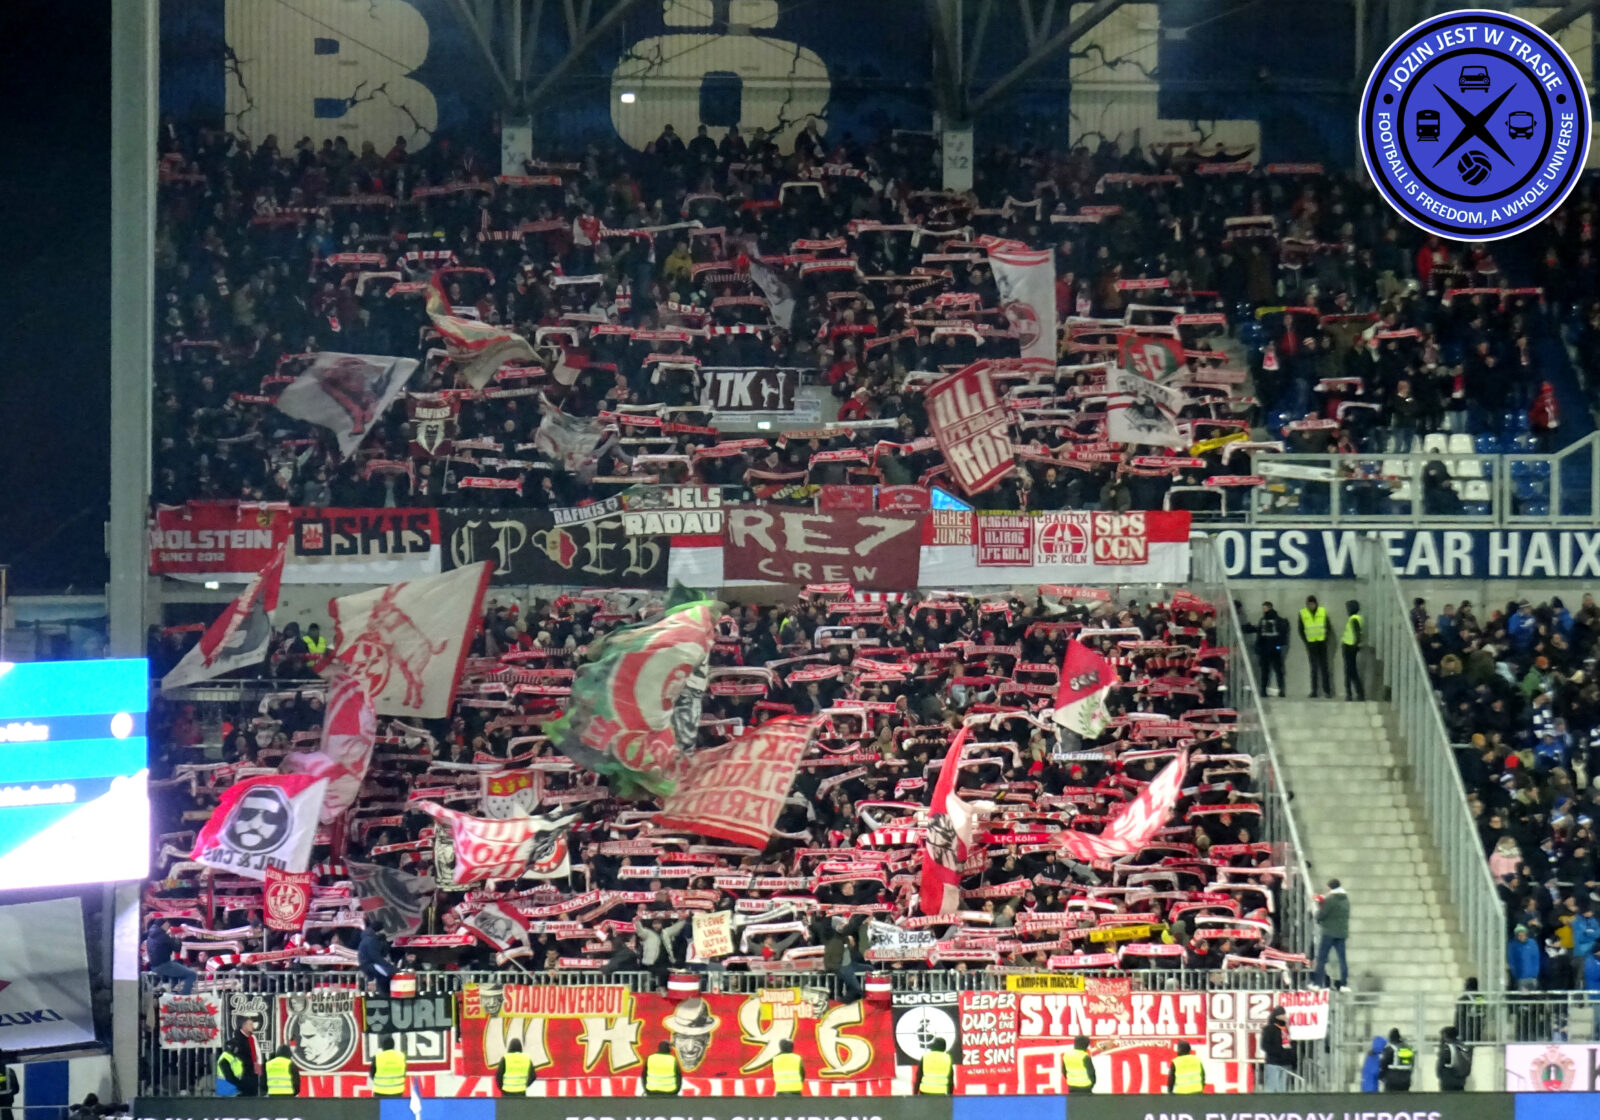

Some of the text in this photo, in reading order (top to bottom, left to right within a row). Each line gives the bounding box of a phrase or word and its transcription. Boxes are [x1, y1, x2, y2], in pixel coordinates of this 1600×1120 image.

[553, 500, 607, 525] RAFIKIS
[624, 511, 721, 536] RADAU
[1095, 514, 1145, 536] SPS
[932, 528, 971, 545] JUNGS
[1095, 537, 1148, 560] CGN
[1489, 530, 1600, 577] HAIX
[758, 558, 877, 582] CREW
[1015, 832, 1037, 843] Köln
[909, 914, 956, 926] SYNDIKAT
[466, 984, 480, 1016] SEK
[503, 985, 625, 1014] STADIONVERBOT
[760, 989, 795, 1003] Junge
[892, 990, 958, 1004] HORDE
[963, 992, 1015, 1010] LEEVER
[311, 1002, 333, 1013] CON
[391, 997, 452, 1029] URL
[773, 1002, 814, 1019] Horde
[999, 1012, 1014, 1021] ALS
[0, 1008, 64, 1026] ZUKI
[1289, 1010, 1318, 1026] KÖLN
[962, 1026, 1016, 1046] KNÄÄCH
[962, 1047, 1016, 1066] ZE SIN!
